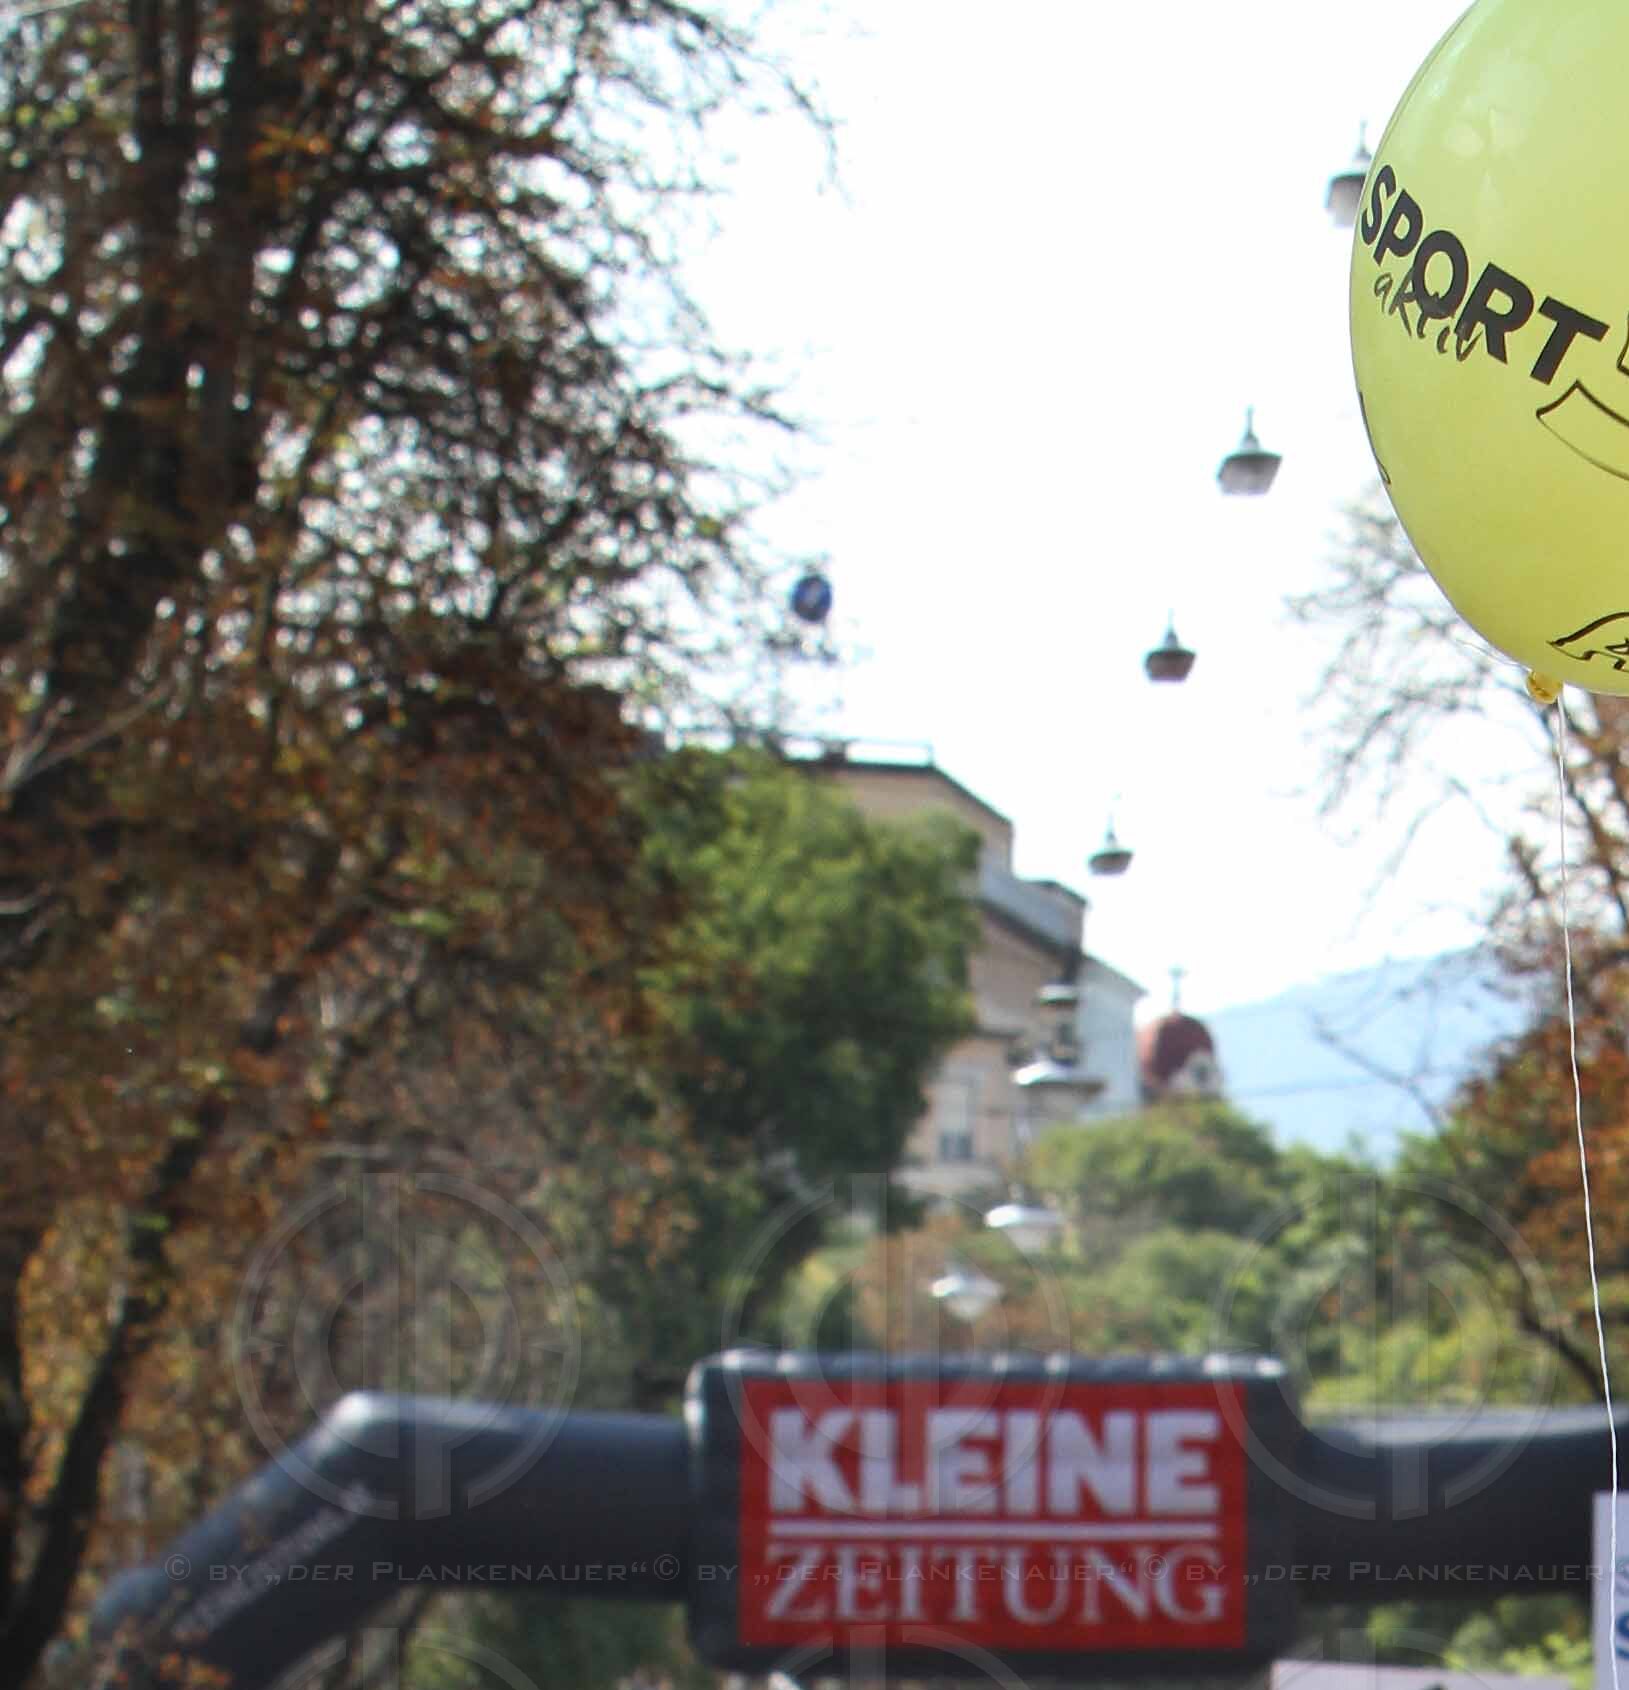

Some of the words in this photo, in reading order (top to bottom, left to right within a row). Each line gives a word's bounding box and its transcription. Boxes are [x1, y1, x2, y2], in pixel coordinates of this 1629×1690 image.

[1358, 163, 1609, 387] SPORT
[766, 1406, 1222, 1518] KLEINE
[765, 1541, 1226, 1626] ZEITUNG
